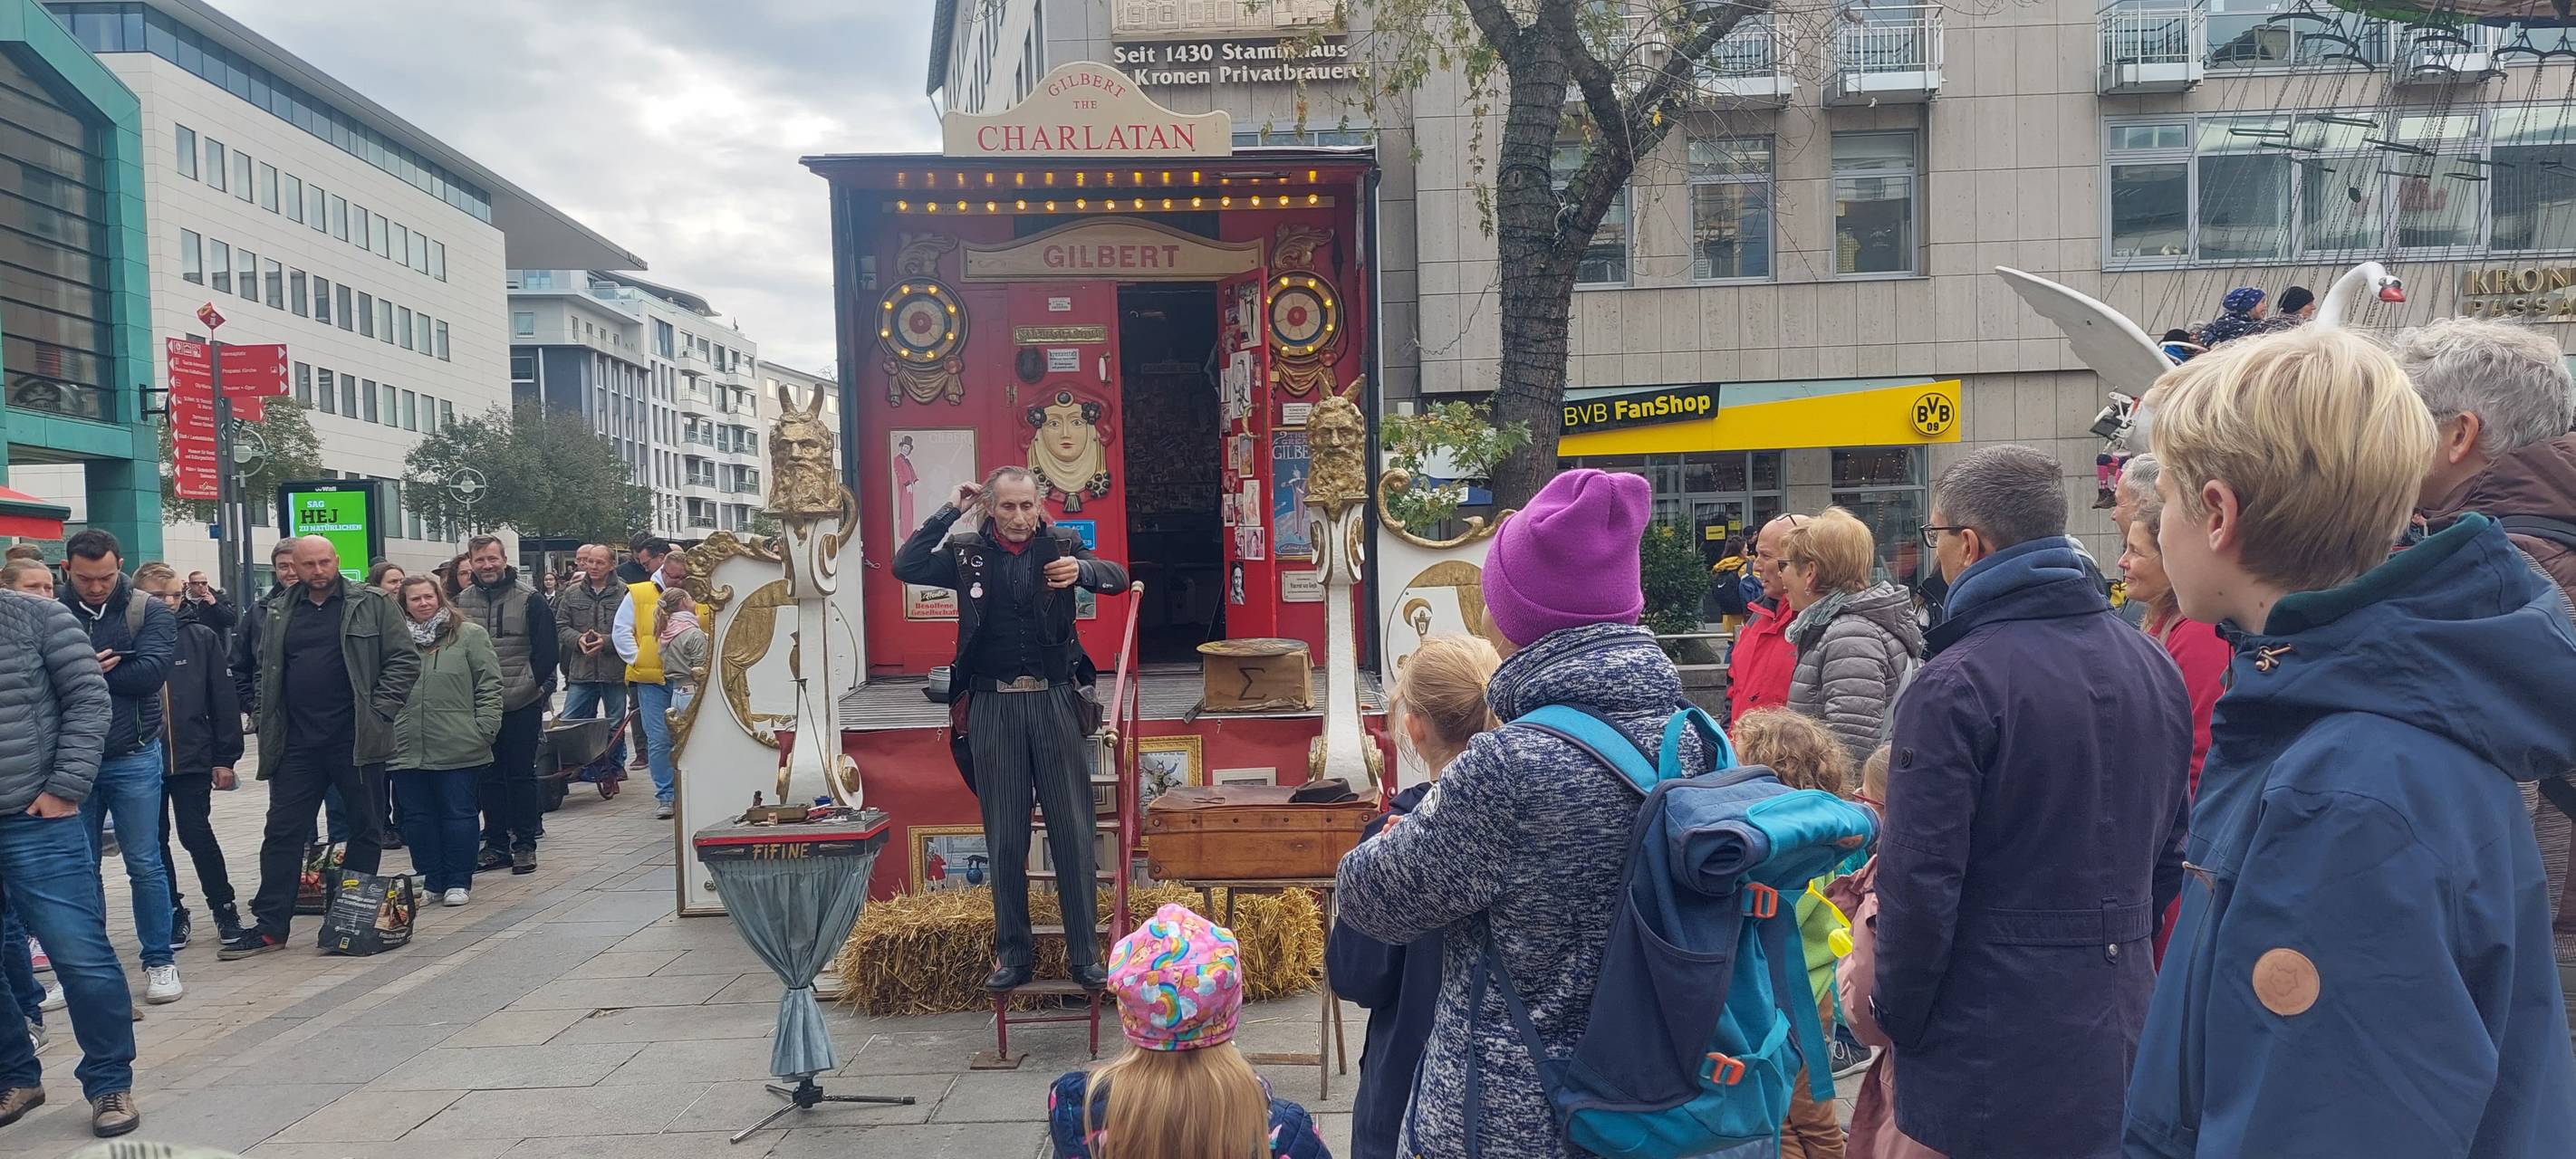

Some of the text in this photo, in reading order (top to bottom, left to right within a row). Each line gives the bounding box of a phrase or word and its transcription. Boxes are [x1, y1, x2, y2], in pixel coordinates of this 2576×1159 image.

[1113, 43, 1350, 63] Seit 1430 Stamaus
[1048, 72, 1127, 100] GILBERT
[1134, 68, 1211, 86] Kronen
[1073, 100, 1099, 110] THE
[977, 123, 1197, 152] CHARLATAN
[1043, 244, 1180, 269] GILBERT
[1564, 395, 1711, 426] BVB FanShop
[1917, 397, 1950, 423] BVB
[1927, 422, 1939, 432] 09
[1272, 445, 1312, 460] GILBE
[306, 500, 325, 508] SAG
[300, 508, 339, 524] HEJ
[310, 523, 362, 532] NATÜRLICHEN
